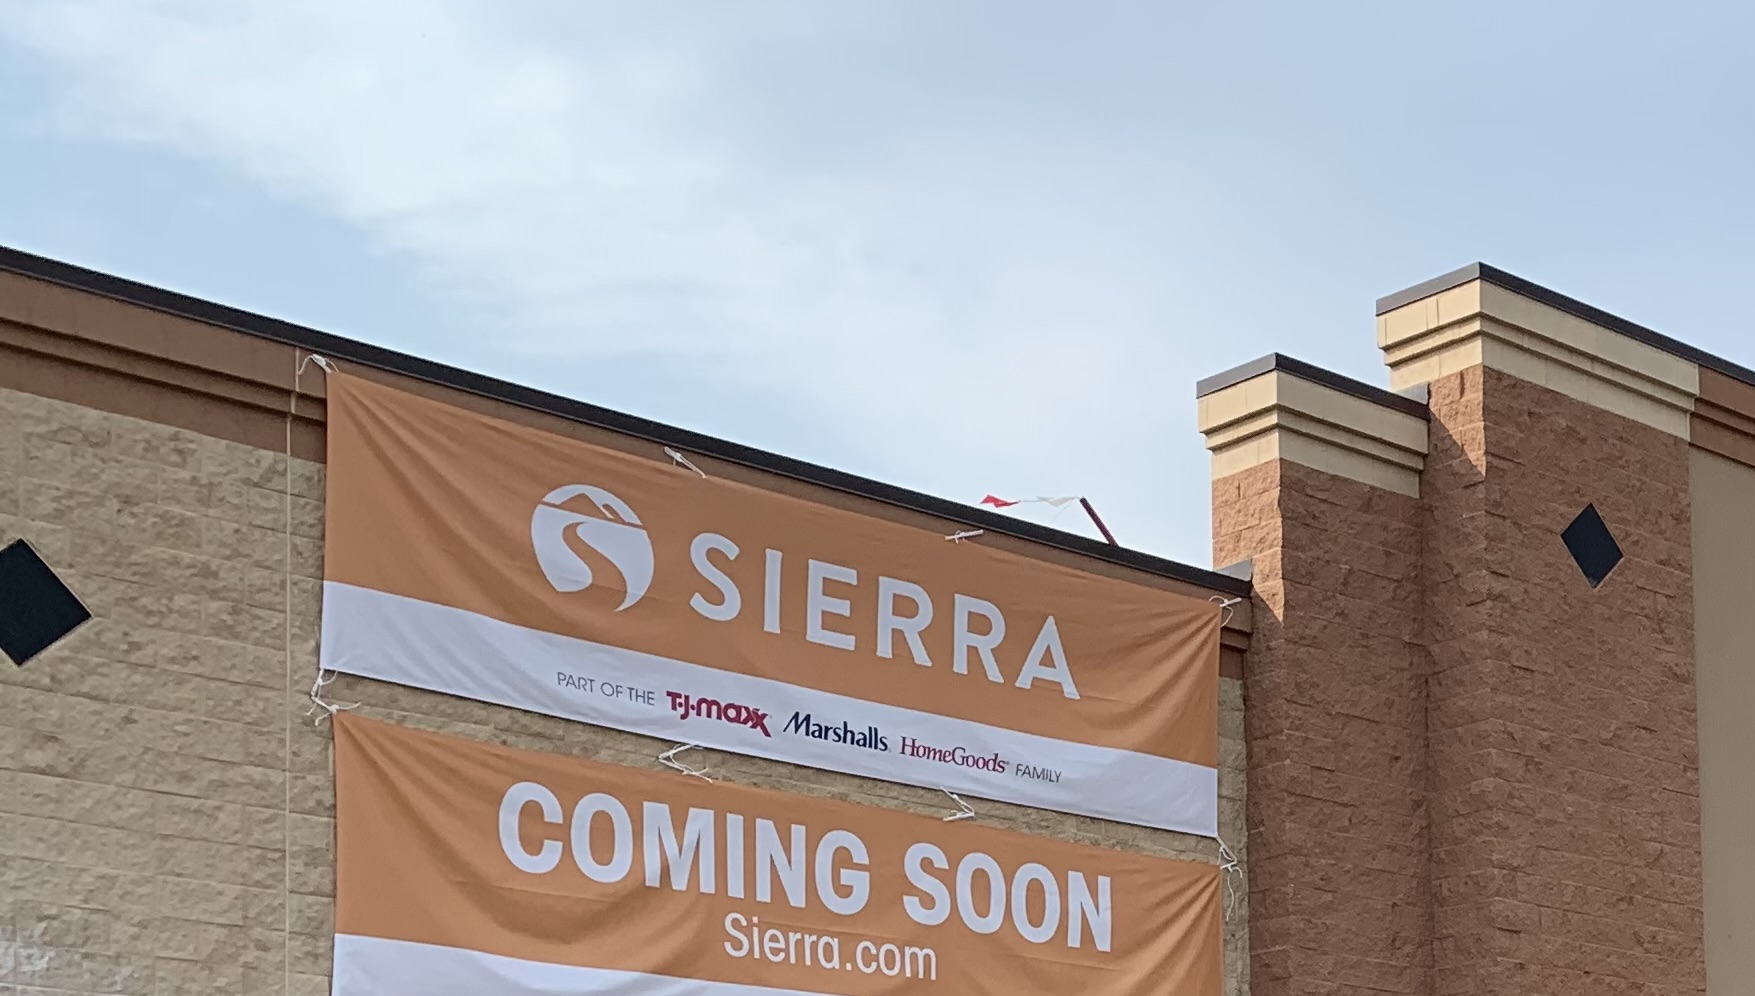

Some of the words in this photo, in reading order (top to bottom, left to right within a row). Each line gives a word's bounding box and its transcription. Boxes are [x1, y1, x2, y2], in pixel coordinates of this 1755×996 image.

[689, 531, 1081, 700] SIERRA
[556, 671, 596, 693] PART
[600, 681, 624, 700] OF
[627, 686, 656, 706] THE
[783, 711, 889, 752] Marshalls
[900, 735, 1007, 774] HomeGoods
[1015, 763, 1063, 784] FAMILY
[497, 780, 871, 916] COMING
[902, 841, 1113, 952] SOON
[723, 911, 938, 982] Sierra.com
